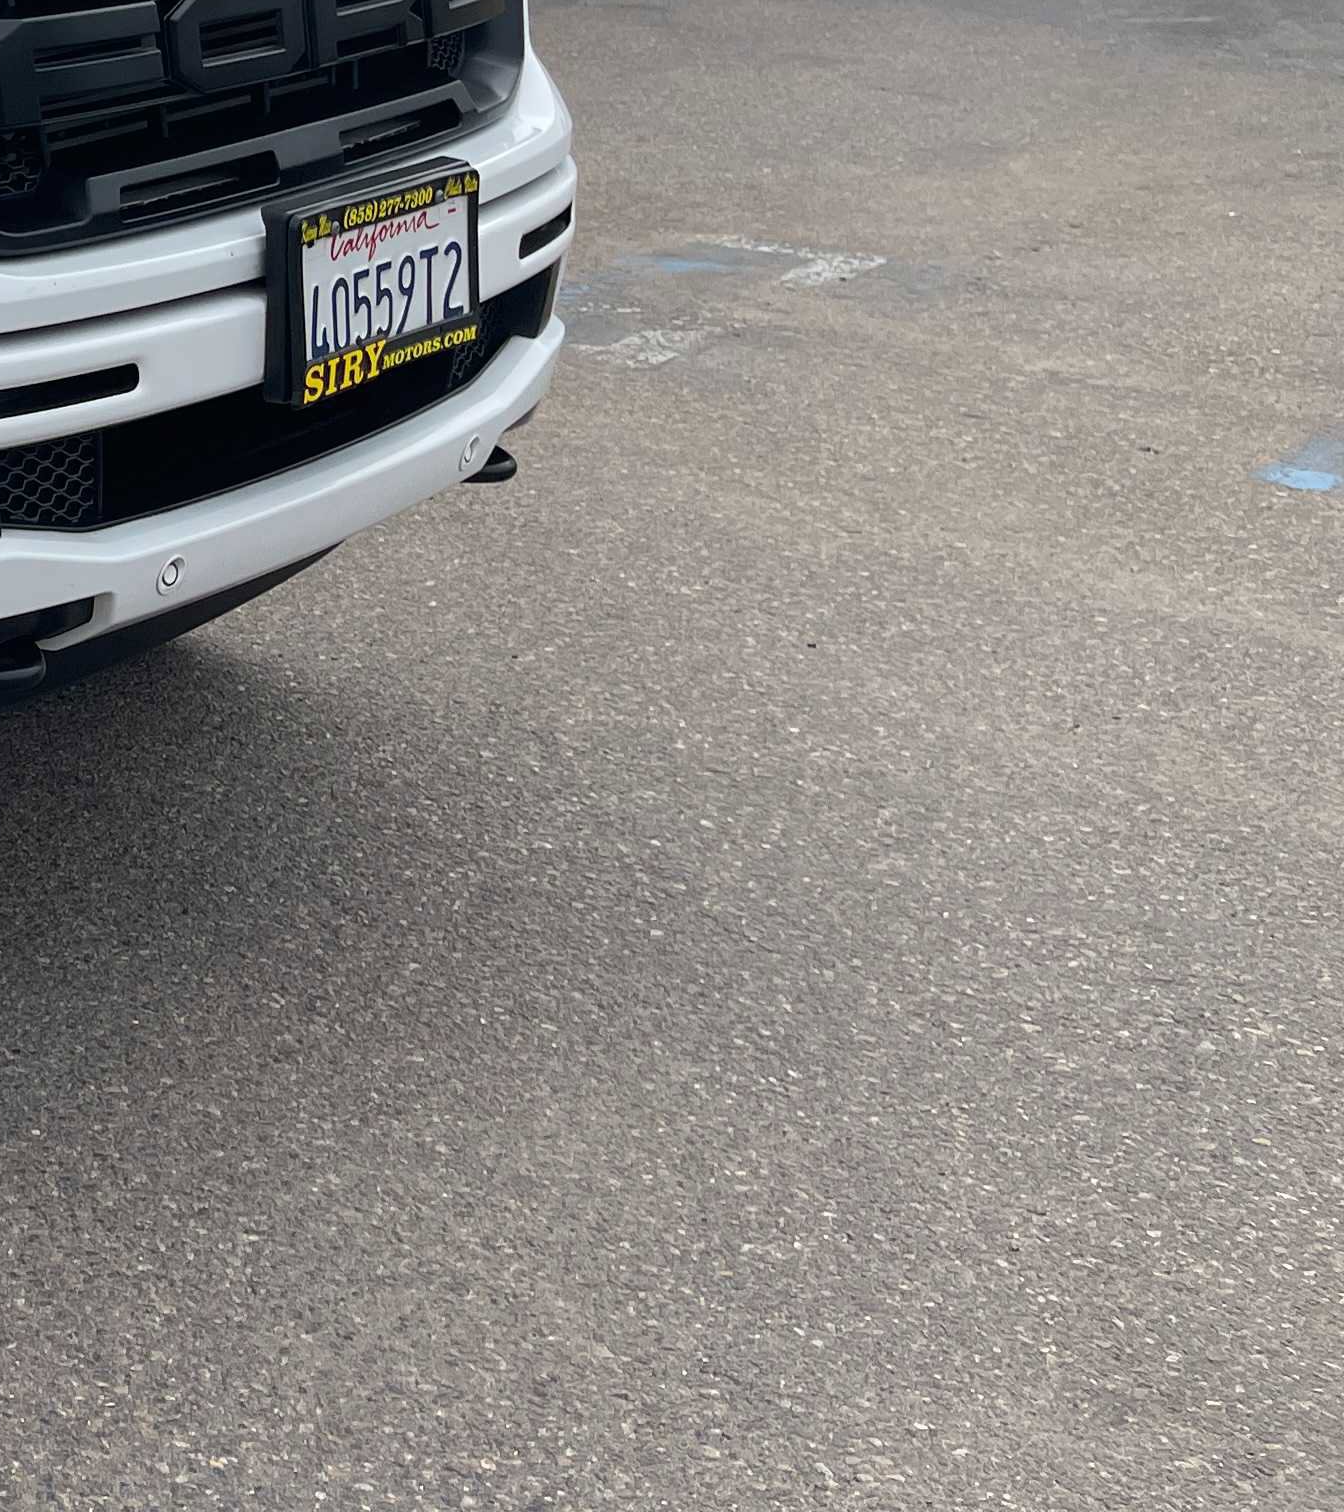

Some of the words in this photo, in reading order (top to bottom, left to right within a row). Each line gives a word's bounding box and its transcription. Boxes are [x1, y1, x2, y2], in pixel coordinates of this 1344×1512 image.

[330, 209, 440, 262] California
[311, 240, 464, 360] 40559T2
[303, 338, 387, 405] SIRY
[382, 325, 478, 370] MOTORS.COM
